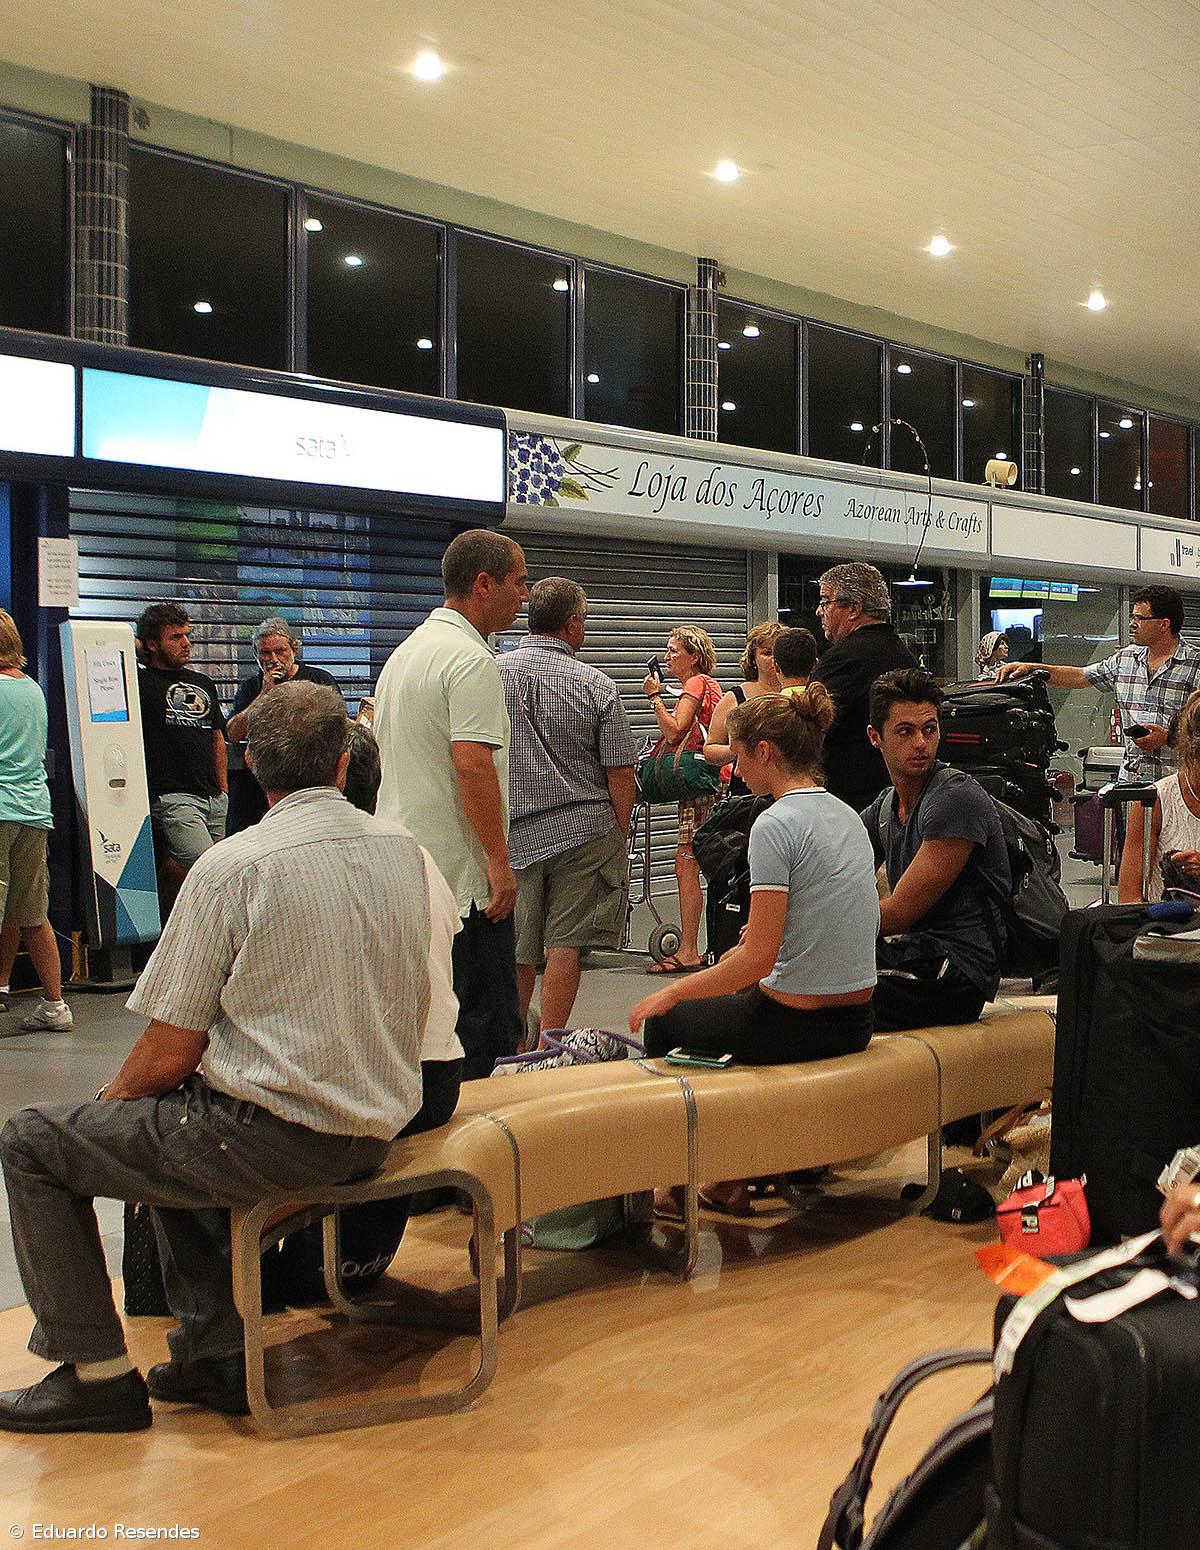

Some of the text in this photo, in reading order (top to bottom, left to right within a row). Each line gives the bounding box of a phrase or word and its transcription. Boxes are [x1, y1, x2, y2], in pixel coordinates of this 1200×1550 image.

[295, 436, 336, 460] sata
[627, 461, 826, 520] Loja dos Açores
[843, 498, 983, 539] Azorean Arts & Crafts
[103, 842, 121, 855] sata
